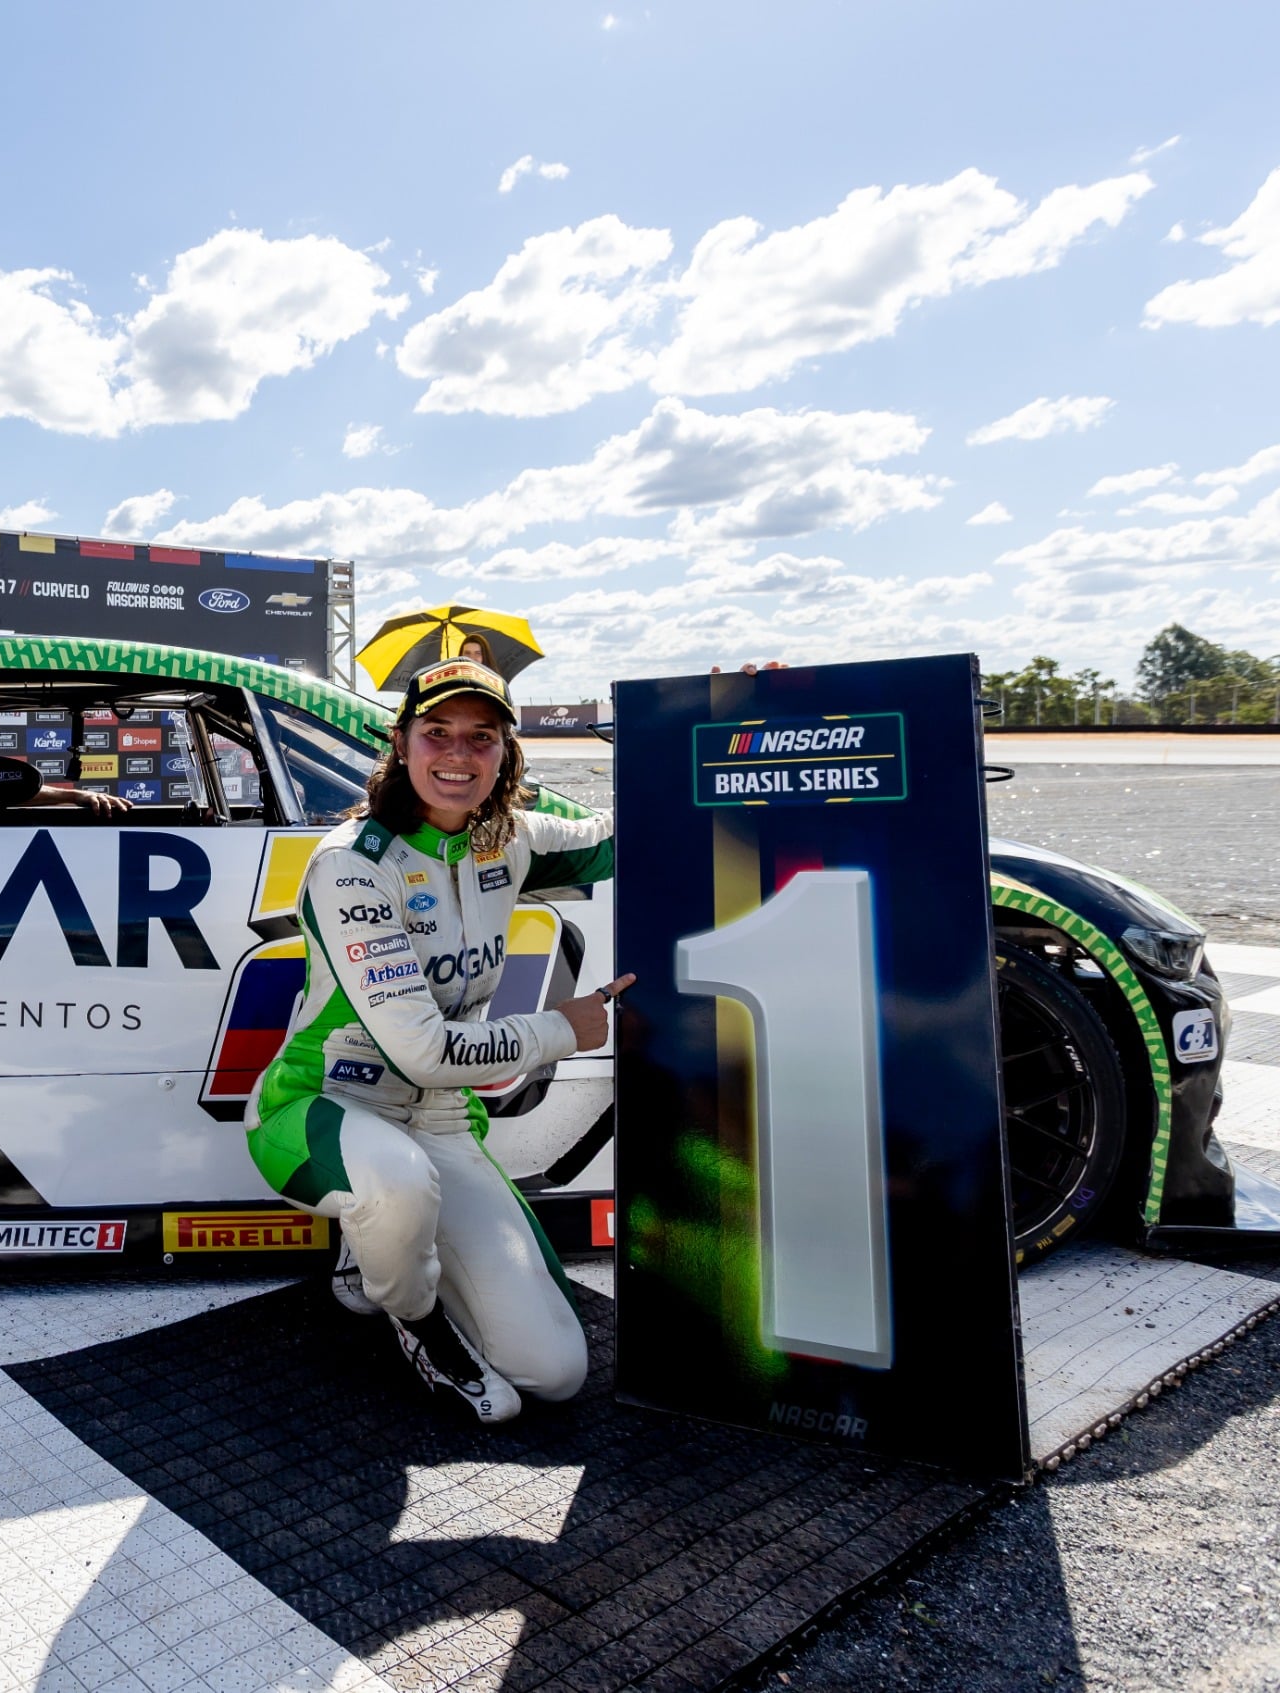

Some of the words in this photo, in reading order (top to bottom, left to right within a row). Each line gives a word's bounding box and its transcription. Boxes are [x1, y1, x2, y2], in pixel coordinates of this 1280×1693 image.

[7, 579, 17, 595] 7
[32, 581, 90, 599] CURVELO
[107, 581, 139, 593] FOLLOW
[138, 584, 150, 594] US
[106, 592, 149, 608] NASCAR
[149, 595, 184, 611] BRASIL
[208, 591, 241, 609] Ford
[265, 609, 313, 617] CHEVROLET
[424, 665, 500, 689] PIRELLI
[539, 716, 578, 726] Karter
[33, 738, 66, 748] Karter
[133, 738, 157, 746] Shopee
[760, 726, 865, 753] NASCAR
[81, 762, 114, 772] IRELLI
[715, 770, 793, 794] BRASIL
[800, 766, 880, 791] SERIES
[126, 789, 155, 799] Karter
[369, 938, 408, 954] Quality
[362, 962, 419, 988] Arbaza
[440, 1028, 520, 1066] Kicaldo
[337, 1065, 358, 1077] AVL
[674, 870, 892, 1370] 1
[177, 1216, 314, 1248] PIRELLI
[768, 1402, 870, 1440] NASCAR
